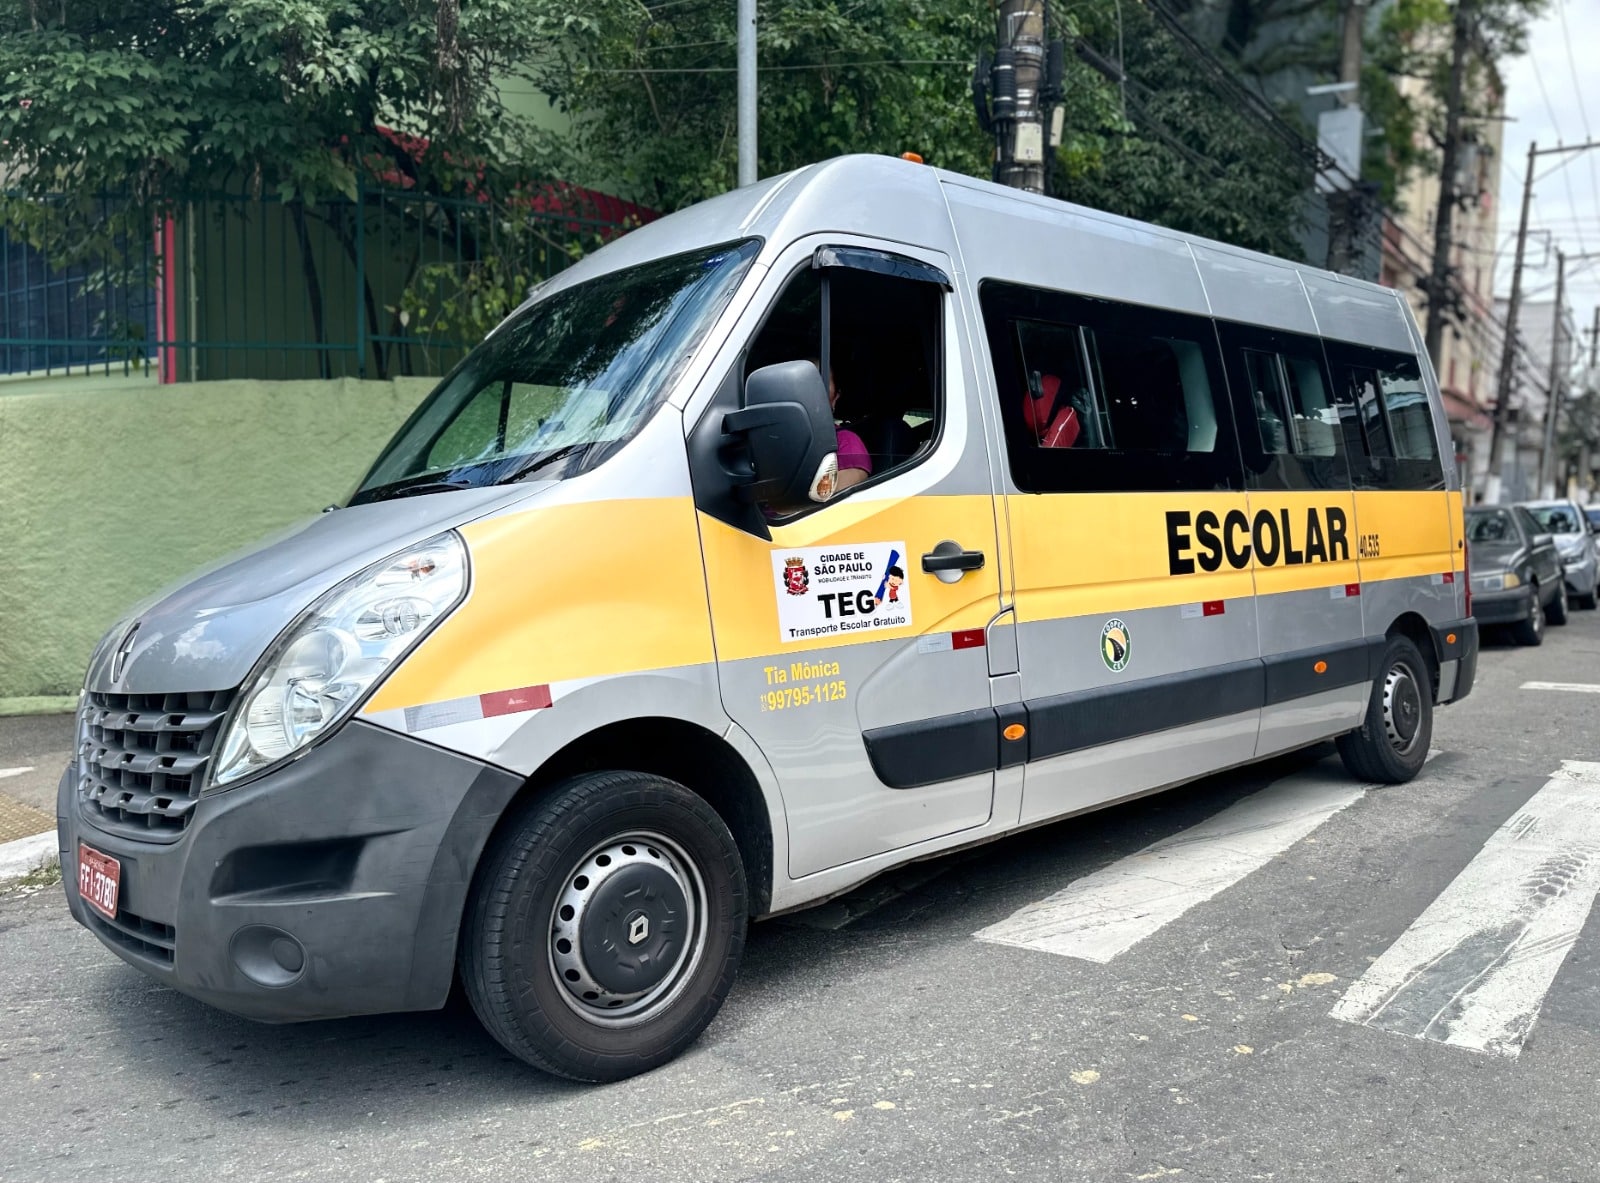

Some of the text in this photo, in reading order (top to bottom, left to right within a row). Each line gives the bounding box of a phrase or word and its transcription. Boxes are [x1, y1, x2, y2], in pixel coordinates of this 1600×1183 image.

[1165, 507, 1350, 576] ESCOLAR
[814, 561, 873, 576] SÃO PAULO
[820, 551, 865, 563] CIDADE DE
[817, 590, 876, 619] TEG
[789, 616, 906, 638] Transporte Escolar Gratuito
[764, 660, 840, 685] Tia Mônica
[767, 680, 847, 711] 99795-1125
